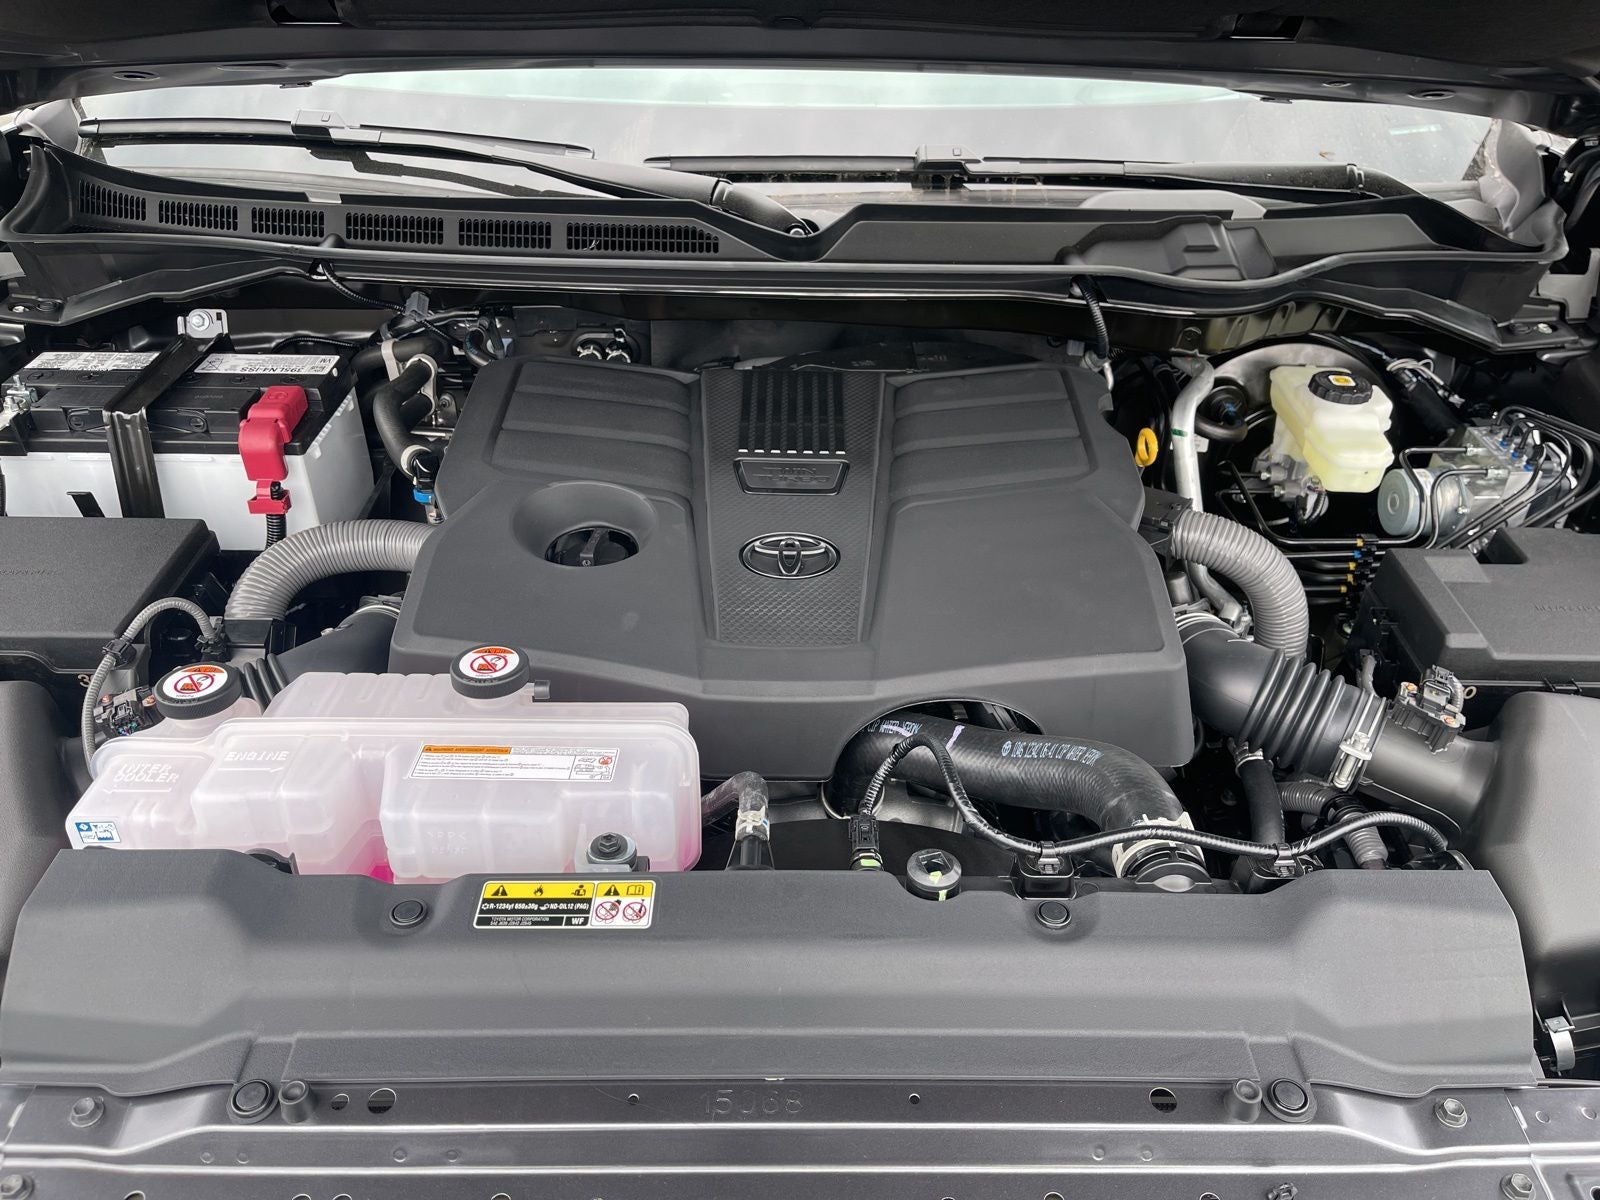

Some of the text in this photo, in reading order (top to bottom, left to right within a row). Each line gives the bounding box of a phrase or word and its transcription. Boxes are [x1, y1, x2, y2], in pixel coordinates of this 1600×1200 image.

[77, 674, 94, 688] 3
[223, 750, 290, 761] ENGINE
[118, 763, 172, 773] INTER
[113, 772, 180, 783] COOLER
[489, 902, 514, 911] R-1234yf
[571, 917, 584, 925] WF
